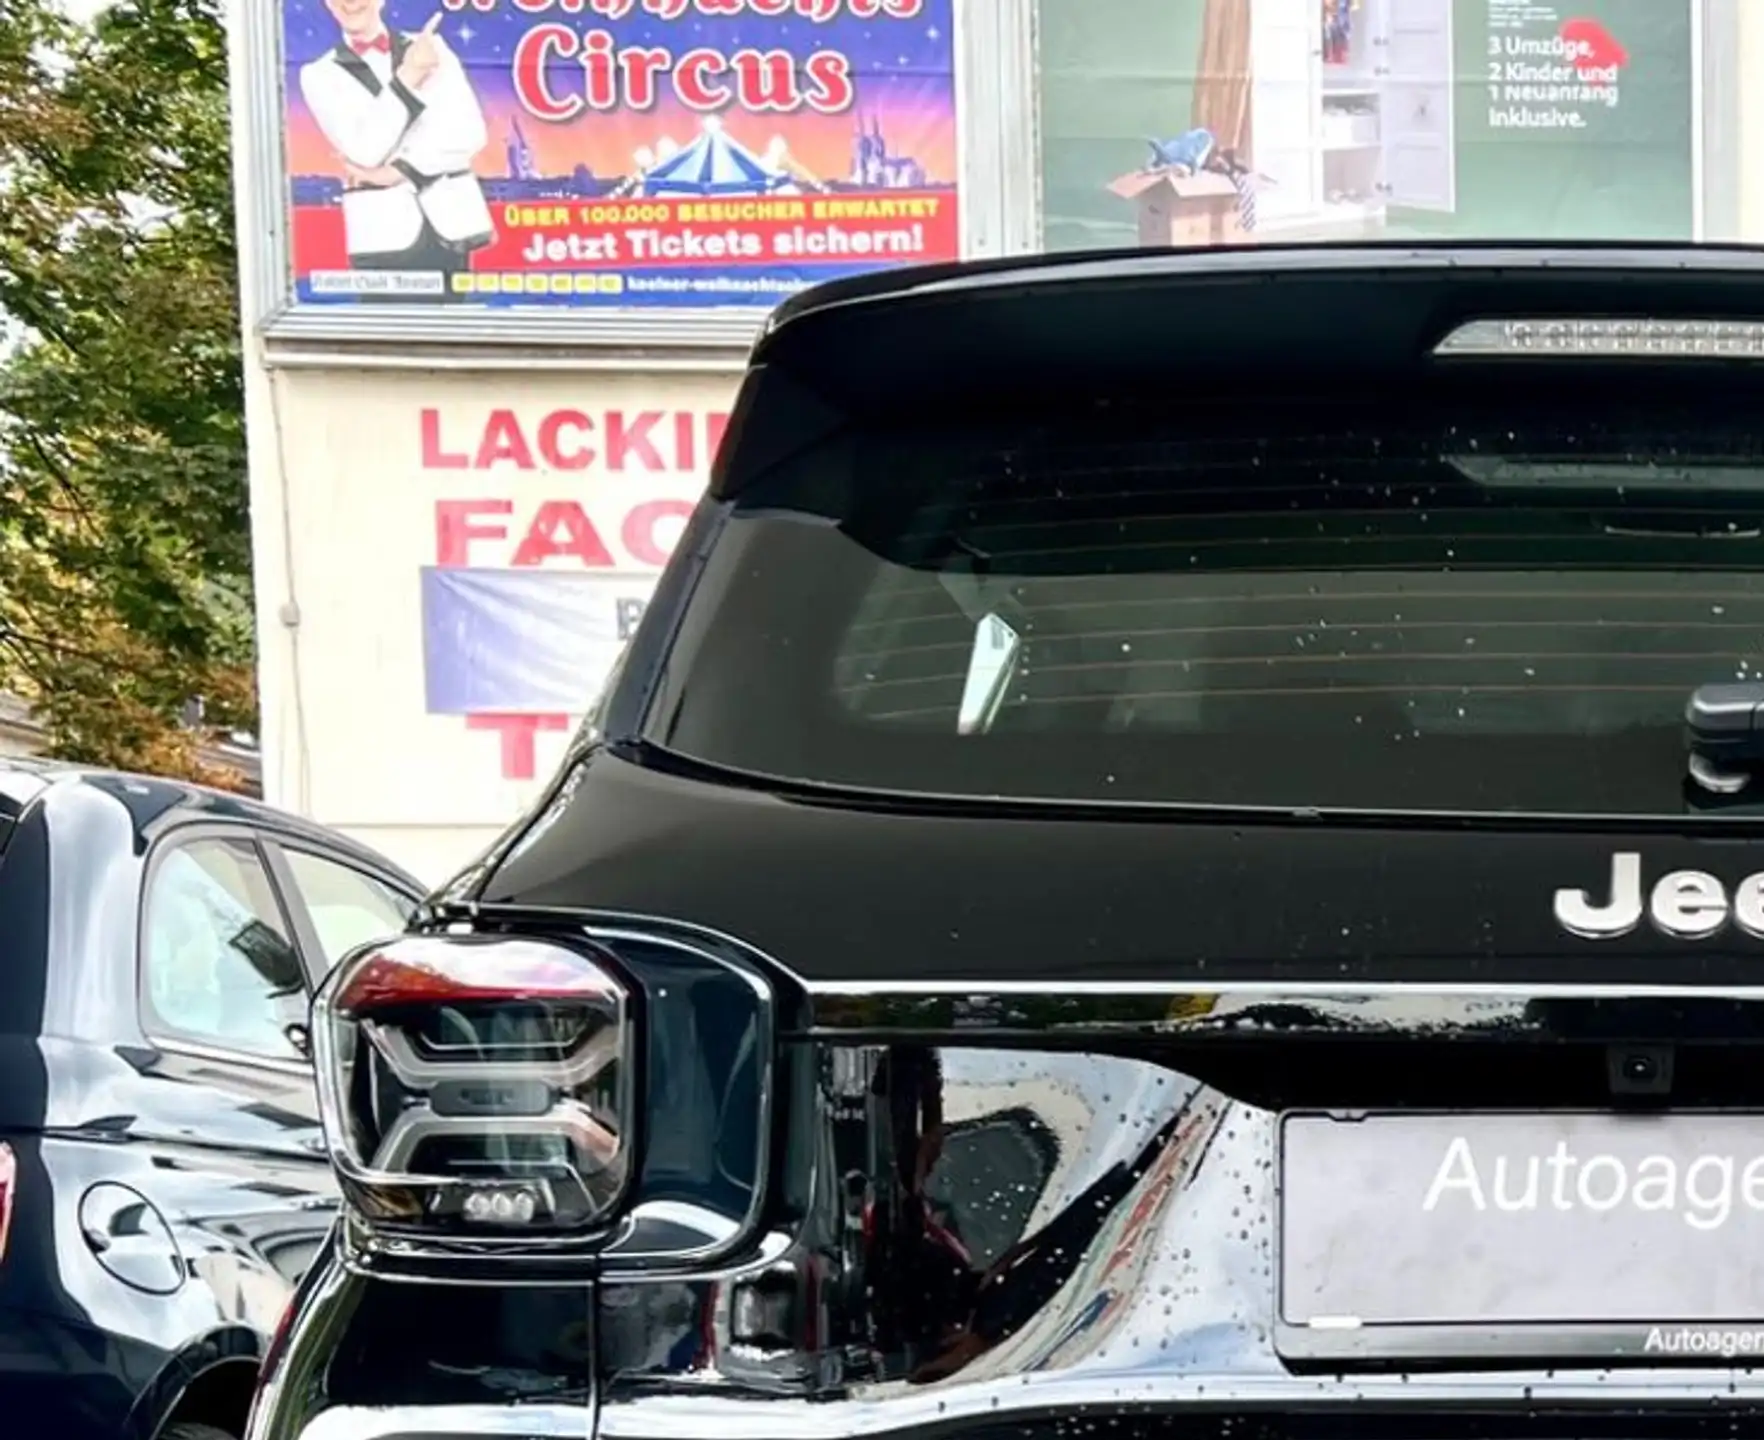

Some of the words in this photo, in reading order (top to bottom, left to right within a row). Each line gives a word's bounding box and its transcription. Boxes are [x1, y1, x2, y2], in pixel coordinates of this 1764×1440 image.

[1488, 36, 1501, 54] 3
[1505, 36, 1595, 61] Umzüge,
[513, 23, 853, 120] Circus
[1488, 62, 1502, 81] 2
[1505, 62, 1573, 81] Kinder
[1577, 64, 1618, 82] und
[1488, 85, 1499, 101] 1
[1504, 85, 1618, 107] Neuanfang
[504, 204, 570, 227] ÜBER
[579, 203, 670, 225] 100.000
[678, 201, 806, 222] BESUCHER
[813, 197, 939, 219] ERWARTET
[523, 231, 619, 261] Jetzt
[625, 228, 763, 258] Tickets
[773, 223, 925, 255] sichern!
